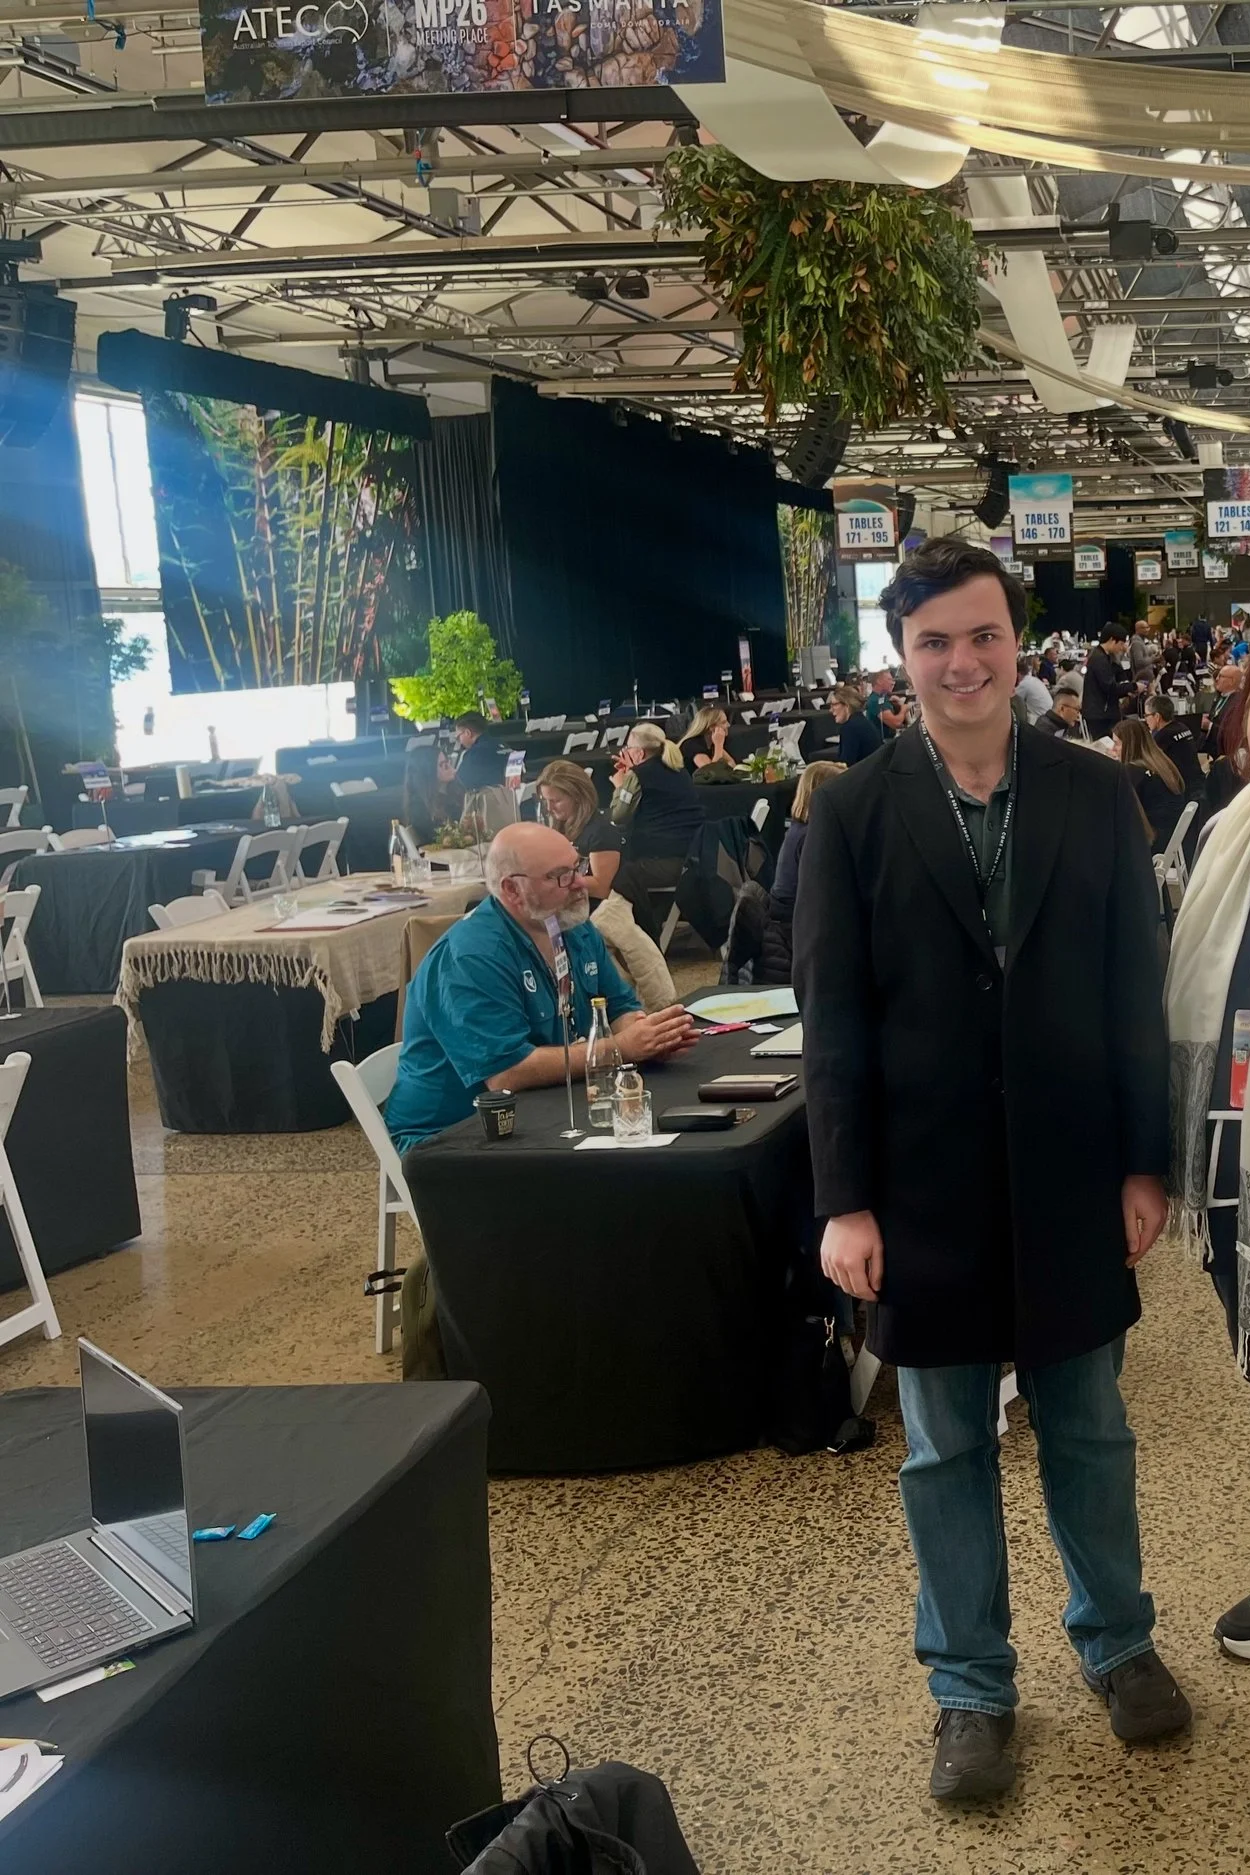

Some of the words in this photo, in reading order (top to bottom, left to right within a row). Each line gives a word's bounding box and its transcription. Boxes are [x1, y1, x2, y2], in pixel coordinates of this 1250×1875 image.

[414, 0, 488, 28] MP26
[233, 4, 321, 41] ATEC
[416, 29, 457, 45] MEETING
[459, 28, 489, 44] PLACE
[849, 517, 883, 529] TABLES
[1025, 512, 1060, 525] TABLES
[1215, 520, 1230, 533] 121
[845, 532, 861, 544] 171
[871, 531, 889, 543] 195
[1020, 528, 1038, 540] 146
[1048, 527, 1066, 539] 170
[924, 736, 938, 762] TASMANIA
[951, 799, 959, 812] FOR
[955, 808, 965, 827] DOWN
[1003, 801, 1013, 828] TASMANIA
[961, 826, 971, 843] COME
[998, 831, 1007, 847] COME
